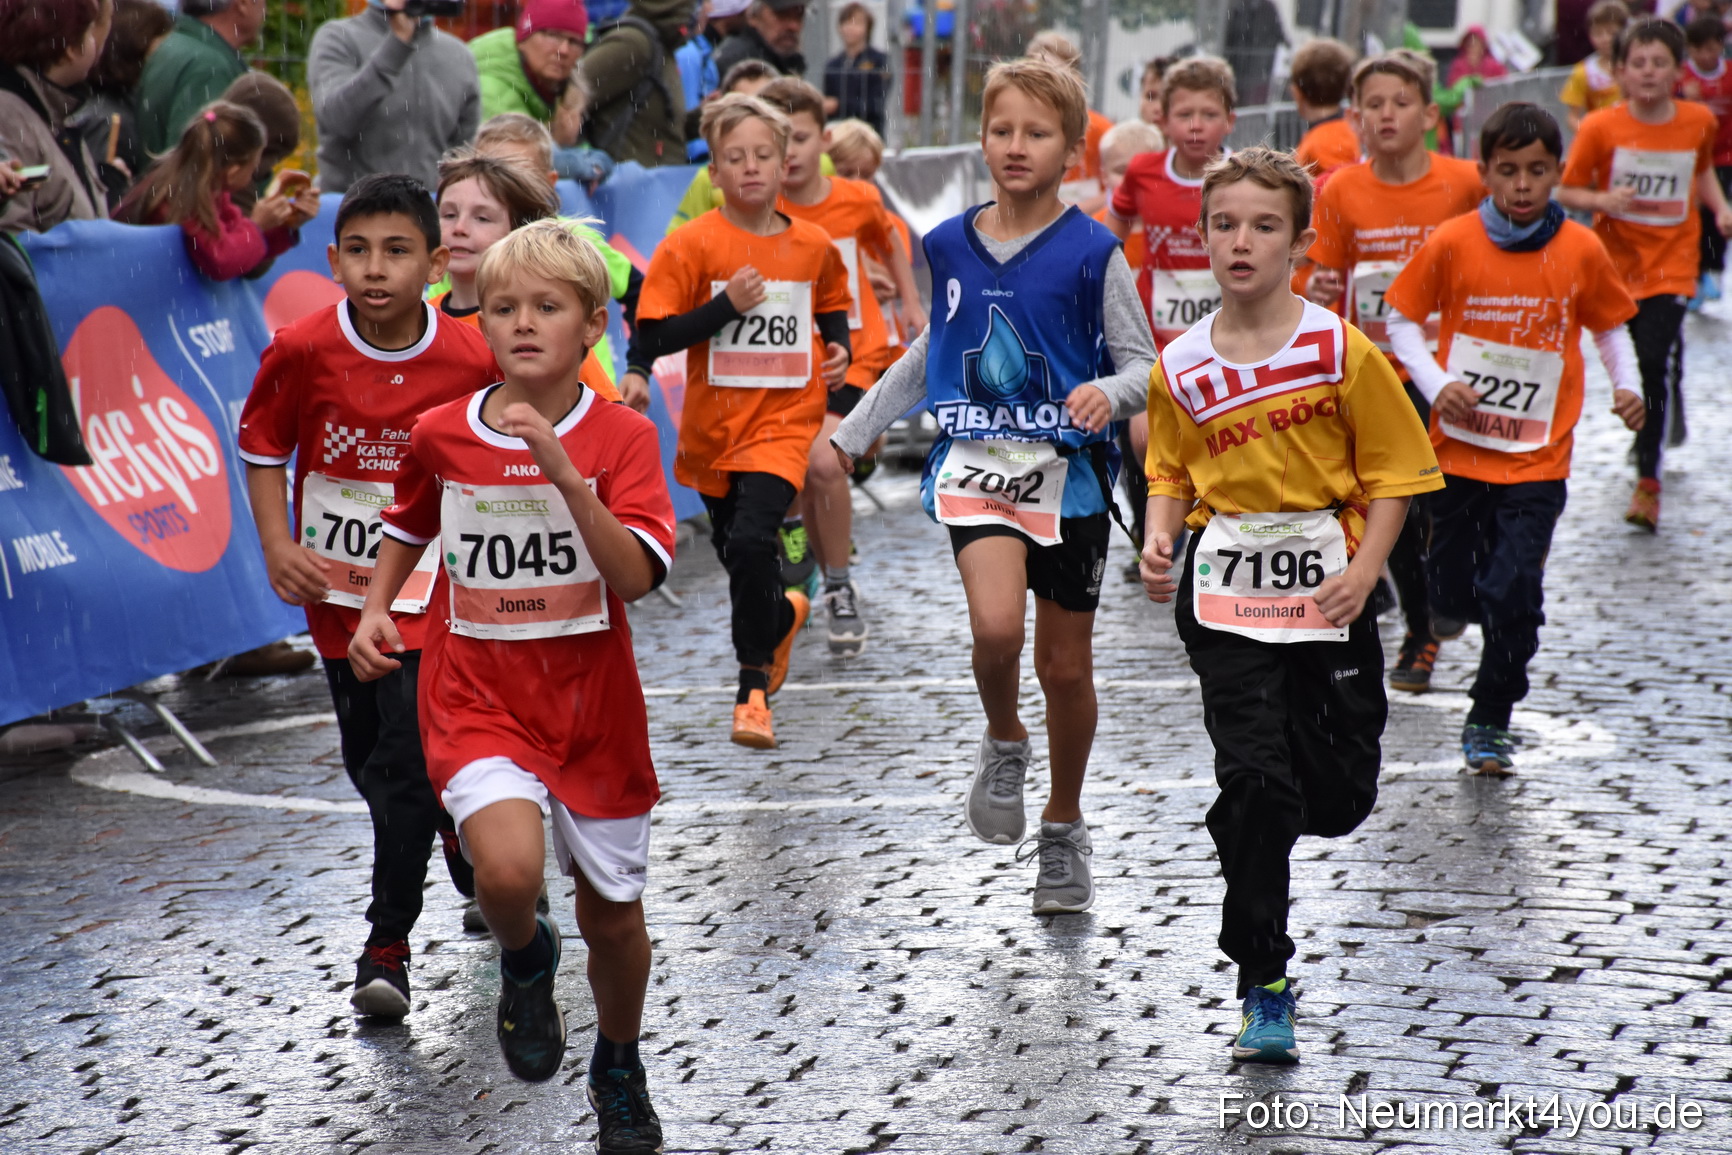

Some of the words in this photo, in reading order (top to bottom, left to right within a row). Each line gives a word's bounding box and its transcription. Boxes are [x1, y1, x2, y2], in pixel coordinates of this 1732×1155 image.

[1625, 172, 1678, 196] 7071
[946, 278, 961, 322] 9
[1167, 299, 1222, 324] 708
[731, 315, 798, 346] 7268
[1463, 371, 1541, 413] 7227
[1267, 397, 1336, 432] BÖG
[381, 428, 411, 440] Fahr
[356, 445, 396, 457] KARG
[357, 458, 401, 471] SCHUC
[503, 465, 541, 477] JAKO
[957, 465, 1044, 504] 7052
[491, 500, 549, 514] BOCK
[127, 503, 190, 544] SPORTS
[323, 512, 383, 559] 702
[12, 530, 77, 574] MOBILE
[306, 540, 316, 550] B6
[460, 530, 577, 580] 7045
[1217, 548, 1325, 590] 7196
[1200, 579, 1210, 588] B6
[496, 597, 546, 613] Jonas
[1235, 603, 1305, 618] Leonhard
[1342, 668, 1359, 677] JAKO
